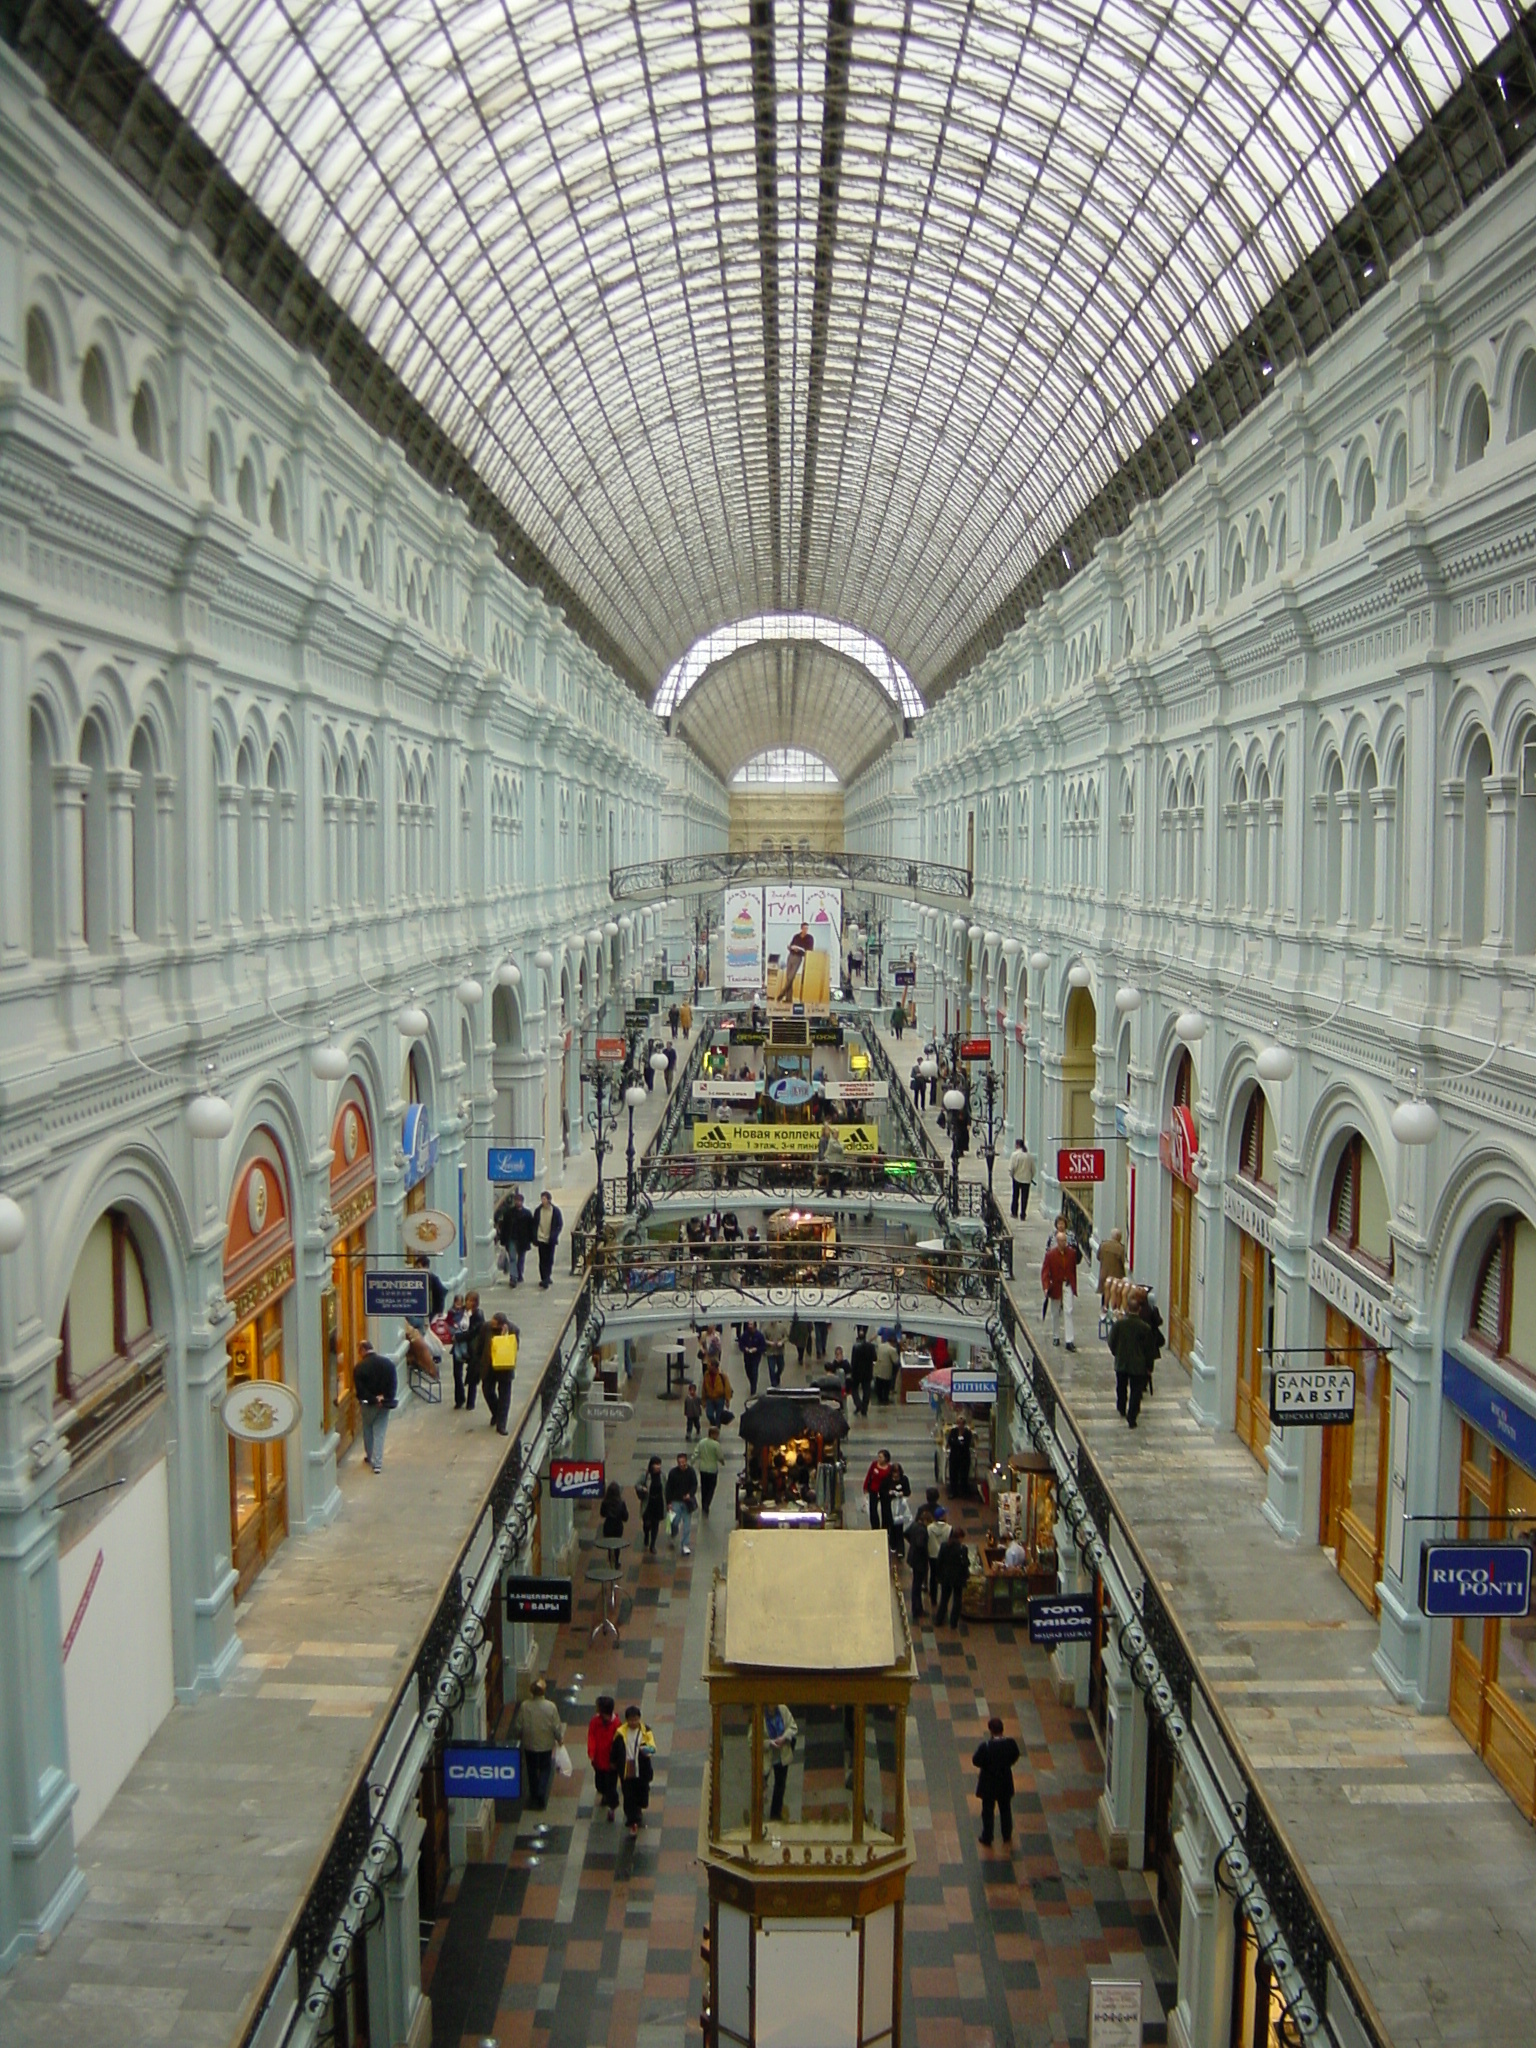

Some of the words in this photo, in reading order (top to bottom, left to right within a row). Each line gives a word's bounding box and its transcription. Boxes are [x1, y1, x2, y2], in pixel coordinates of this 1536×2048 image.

[734, 1127, 771, 1139] Новая
[697, 1140, 732, 1149] adidas
[1069, 1152, 1095, 1174] SiSi
[368, 1280, 425, 1290] PIONEER
[1311, 1258, 1348, 1308] SANDRA
[953, 1382, 997, 1392] ОПТИКА
[1277, 1375, 1352, 1389] SANDRA
[1282, 1390, 1345, 1404] PABST
[1433, 1569, 1490, 1583] RICO
[1460, 1582, 1523, 1596] PONTI
[519, 1602, 560, 1610] ТОВАРЫ
[1032, 1617, 1093, 1627] TAILOR
[448, 1765, 516, 1779] CASIO
